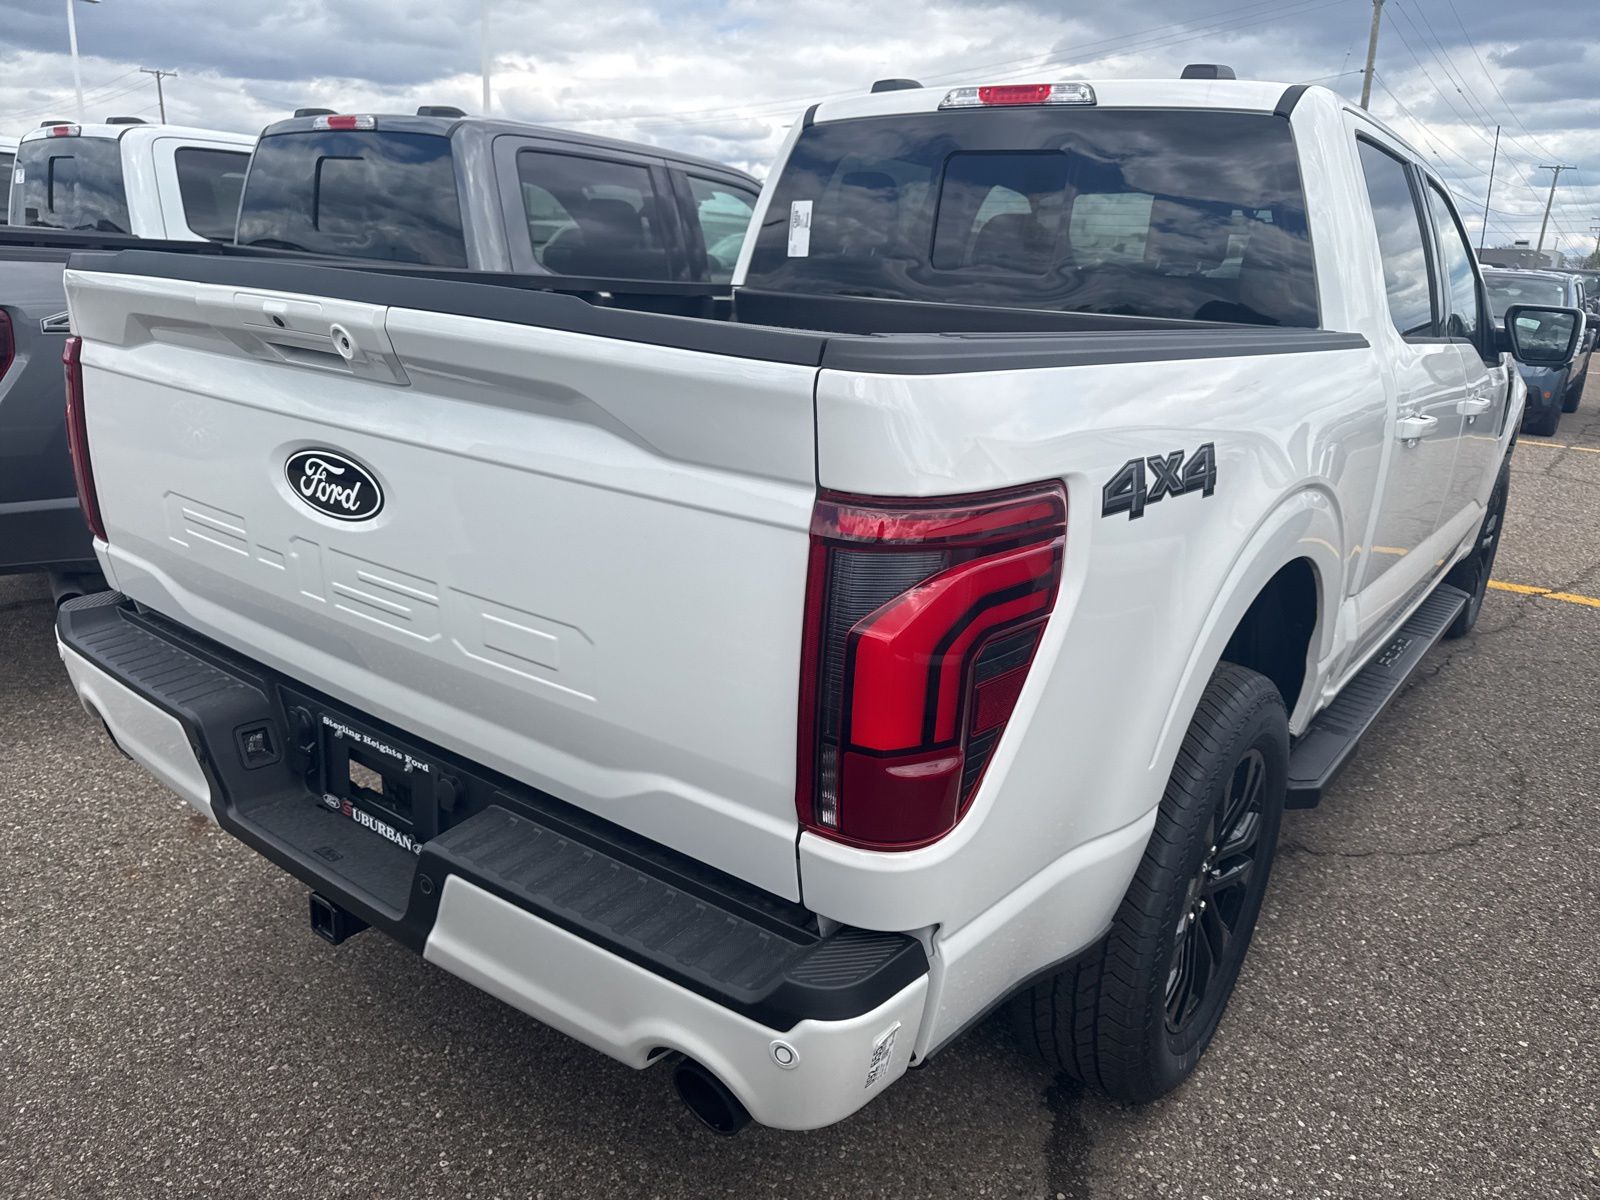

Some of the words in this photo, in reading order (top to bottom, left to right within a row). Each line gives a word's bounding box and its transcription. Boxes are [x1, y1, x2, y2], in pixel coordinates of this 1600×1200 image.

[300, 457, 361, 511] Ford
[163, 490, 597, 702] F-150
[322, 716, 362, 741] Sterling
[363, 734, 403, 760] Heights
[404, 753, 430, 773] Ford
[341, 798, 412, 851] SUBURBAN
